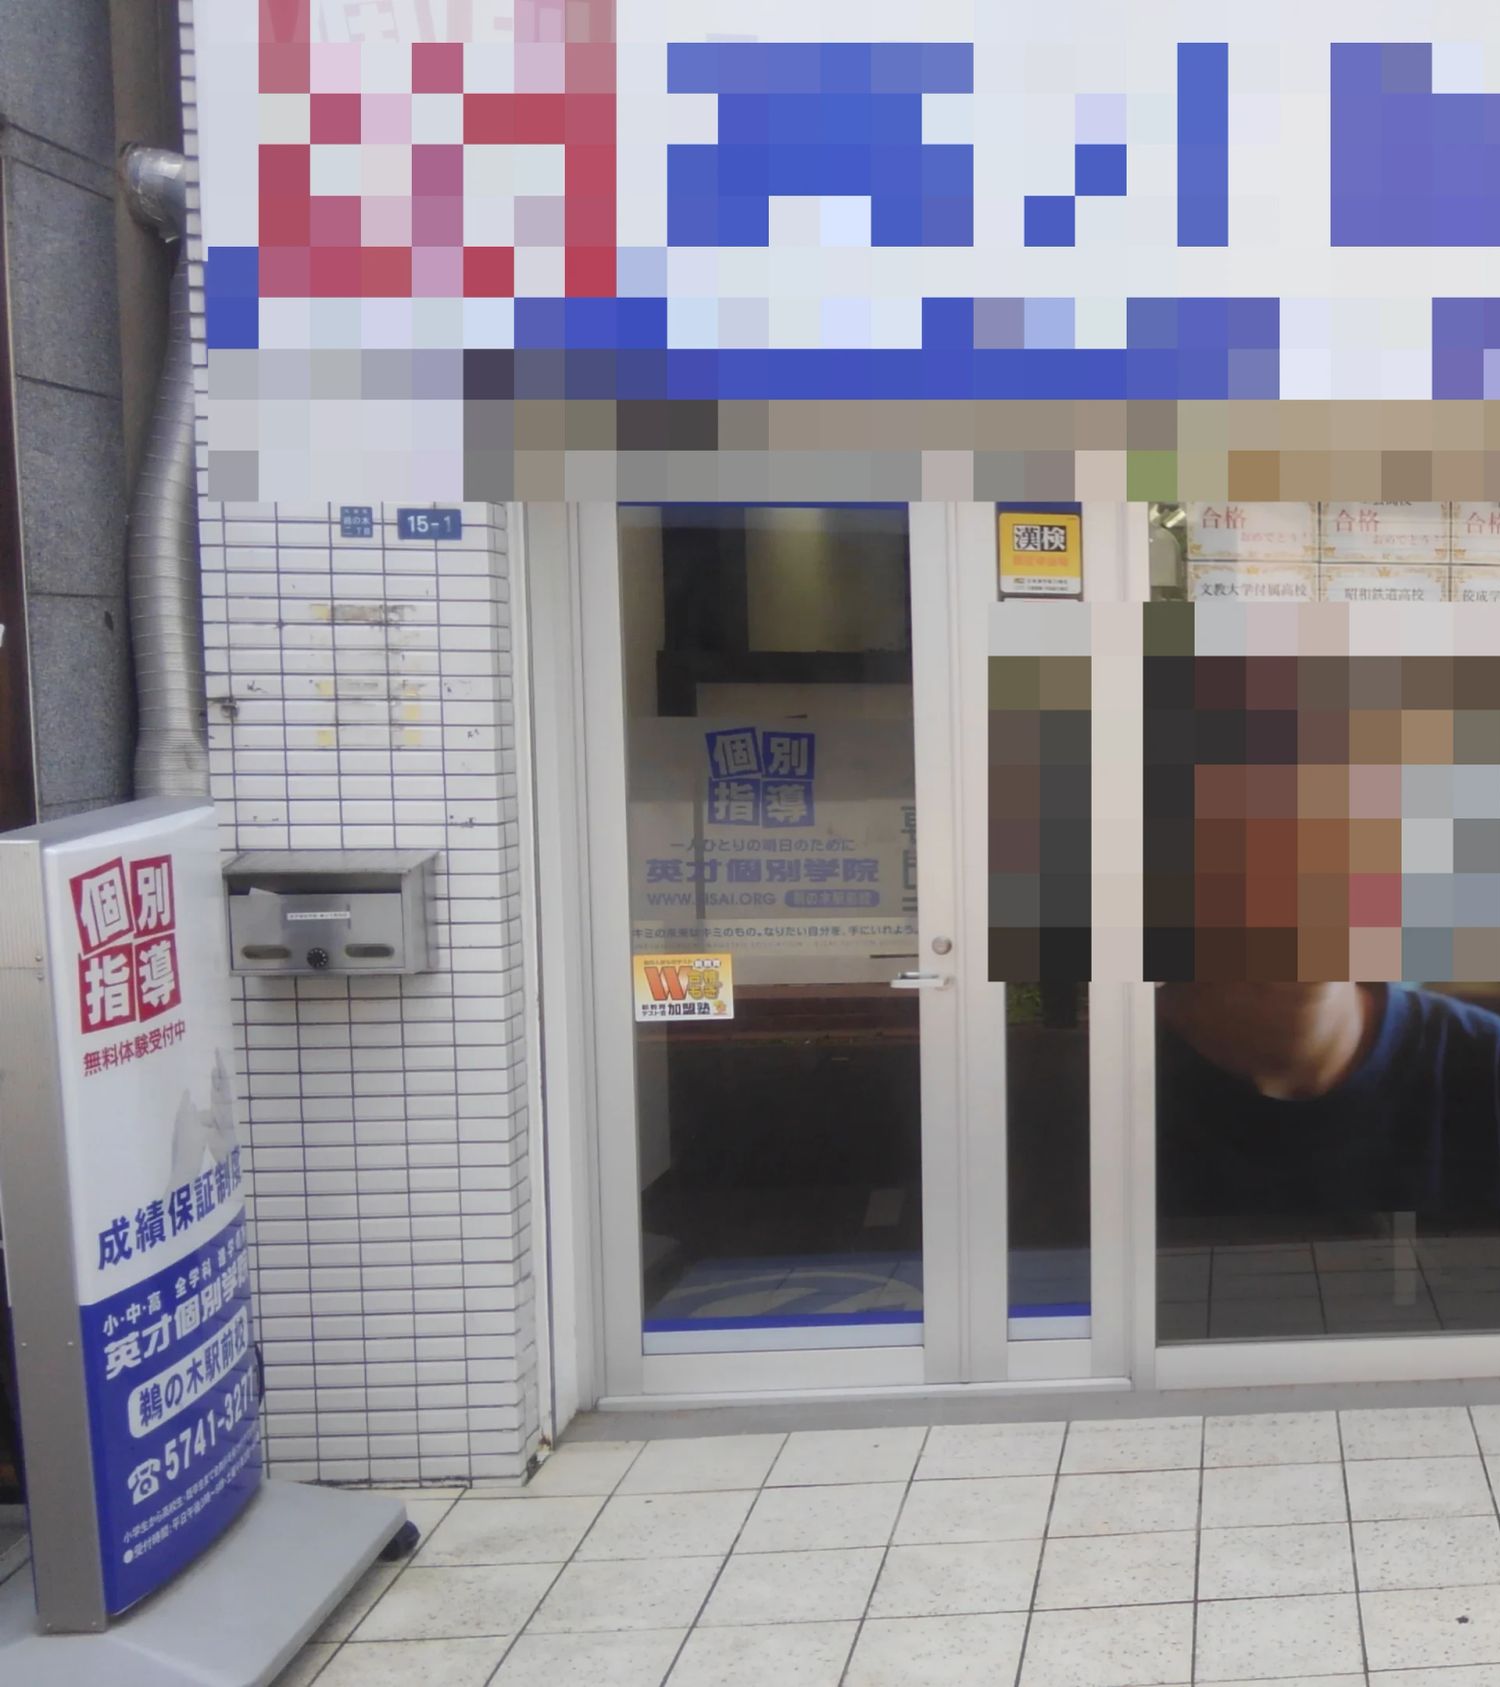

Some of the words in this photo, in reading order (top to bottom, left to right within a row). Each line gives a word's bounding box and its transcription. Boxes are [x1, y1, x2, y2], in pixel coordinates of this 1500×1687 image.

[408, 515, 451, 533] 15-1
[1015, 525, 1066, 551] 漢検
[1203, 506, 1246, 529] 合格
[1336, 510, 1380, 532] 合格
[711, 733, 809, 777] 個別
[714, 782, 808, 825] 指導
[646, 858, 879, 883] 英才個別学院
[79, 861, 171, 948] 個別
[646, 892, 777, 906] WWW.ISAI.ORG
[85, 941, 178, 1025] 指導
[668, 1002, 711, 1015] 加盟塾
[82, 1020, 186, 1077] 無料体験受付中
[98, 1145, 243, 1271] 成績保証制度
[104, 1248, 249, 1380] 英才個別学院
[138, 1315, 247, 1428] 鵜の木駅前校
